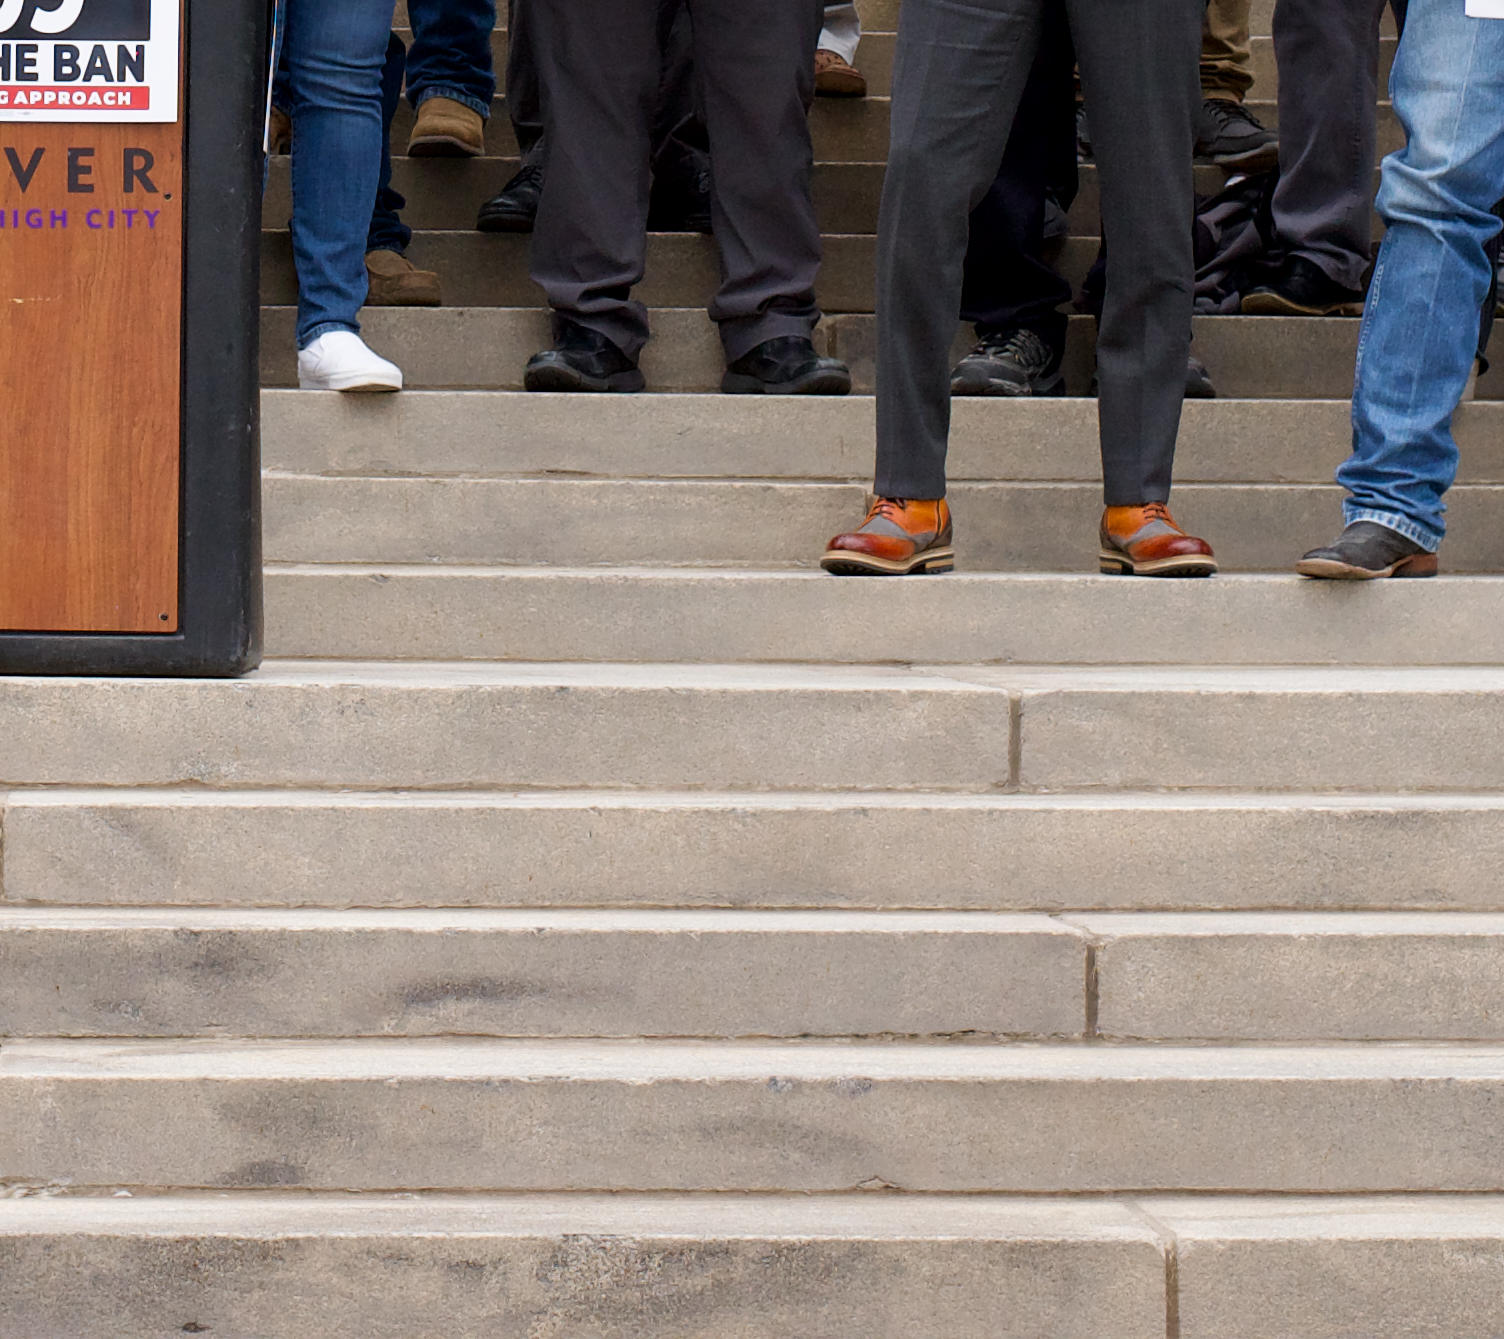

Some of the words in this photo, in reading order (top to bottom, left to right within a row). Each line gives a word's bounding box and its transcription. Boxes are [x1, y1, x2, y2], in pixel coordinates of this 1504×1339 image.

[54, 44, 144, 82] BAN
[13, 91, 130, 105] APPROACH
[85, 210, 161, 229] CITY
